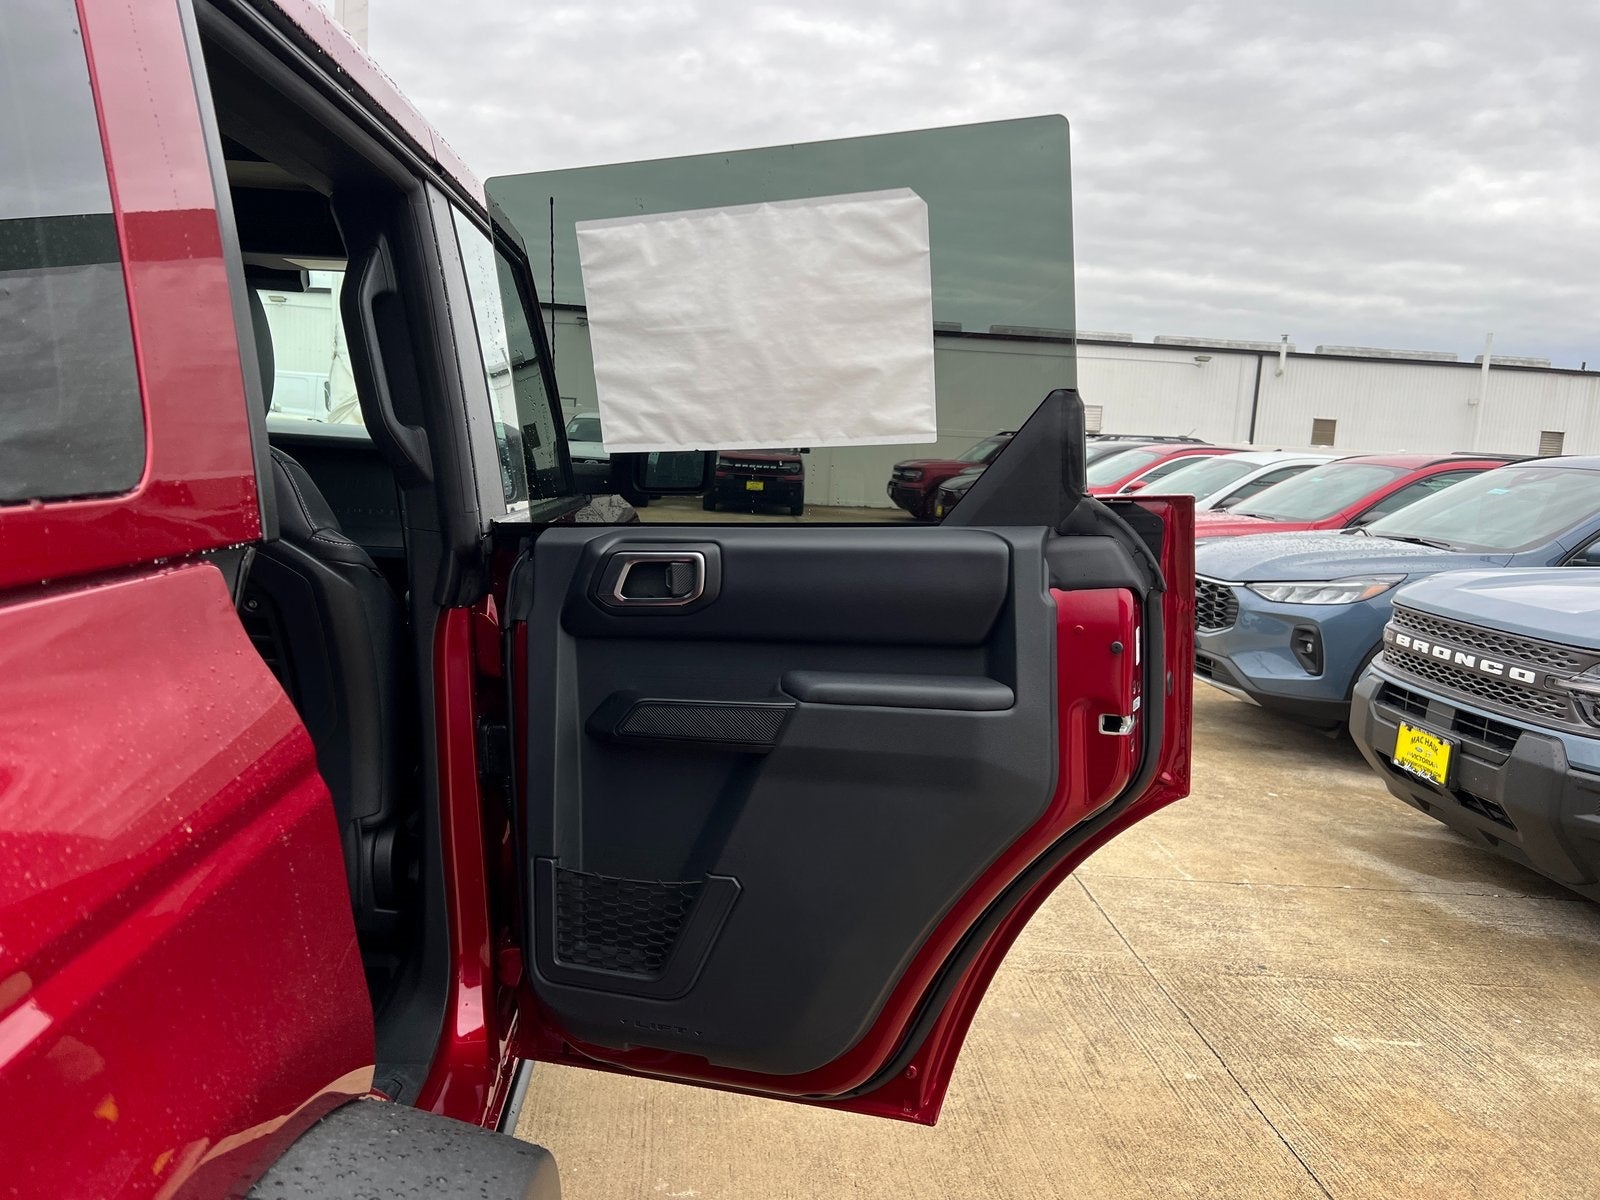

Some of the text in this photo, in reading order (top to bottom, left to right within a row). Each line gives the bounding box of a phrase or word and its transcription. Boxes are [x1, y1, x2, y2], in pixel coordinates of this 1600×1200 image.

[1395, 633, 1536, 684] BRONCO
[1410, 736, 1424, 745] MAC
[1411, 752, 1434, 767] VICTORIA
